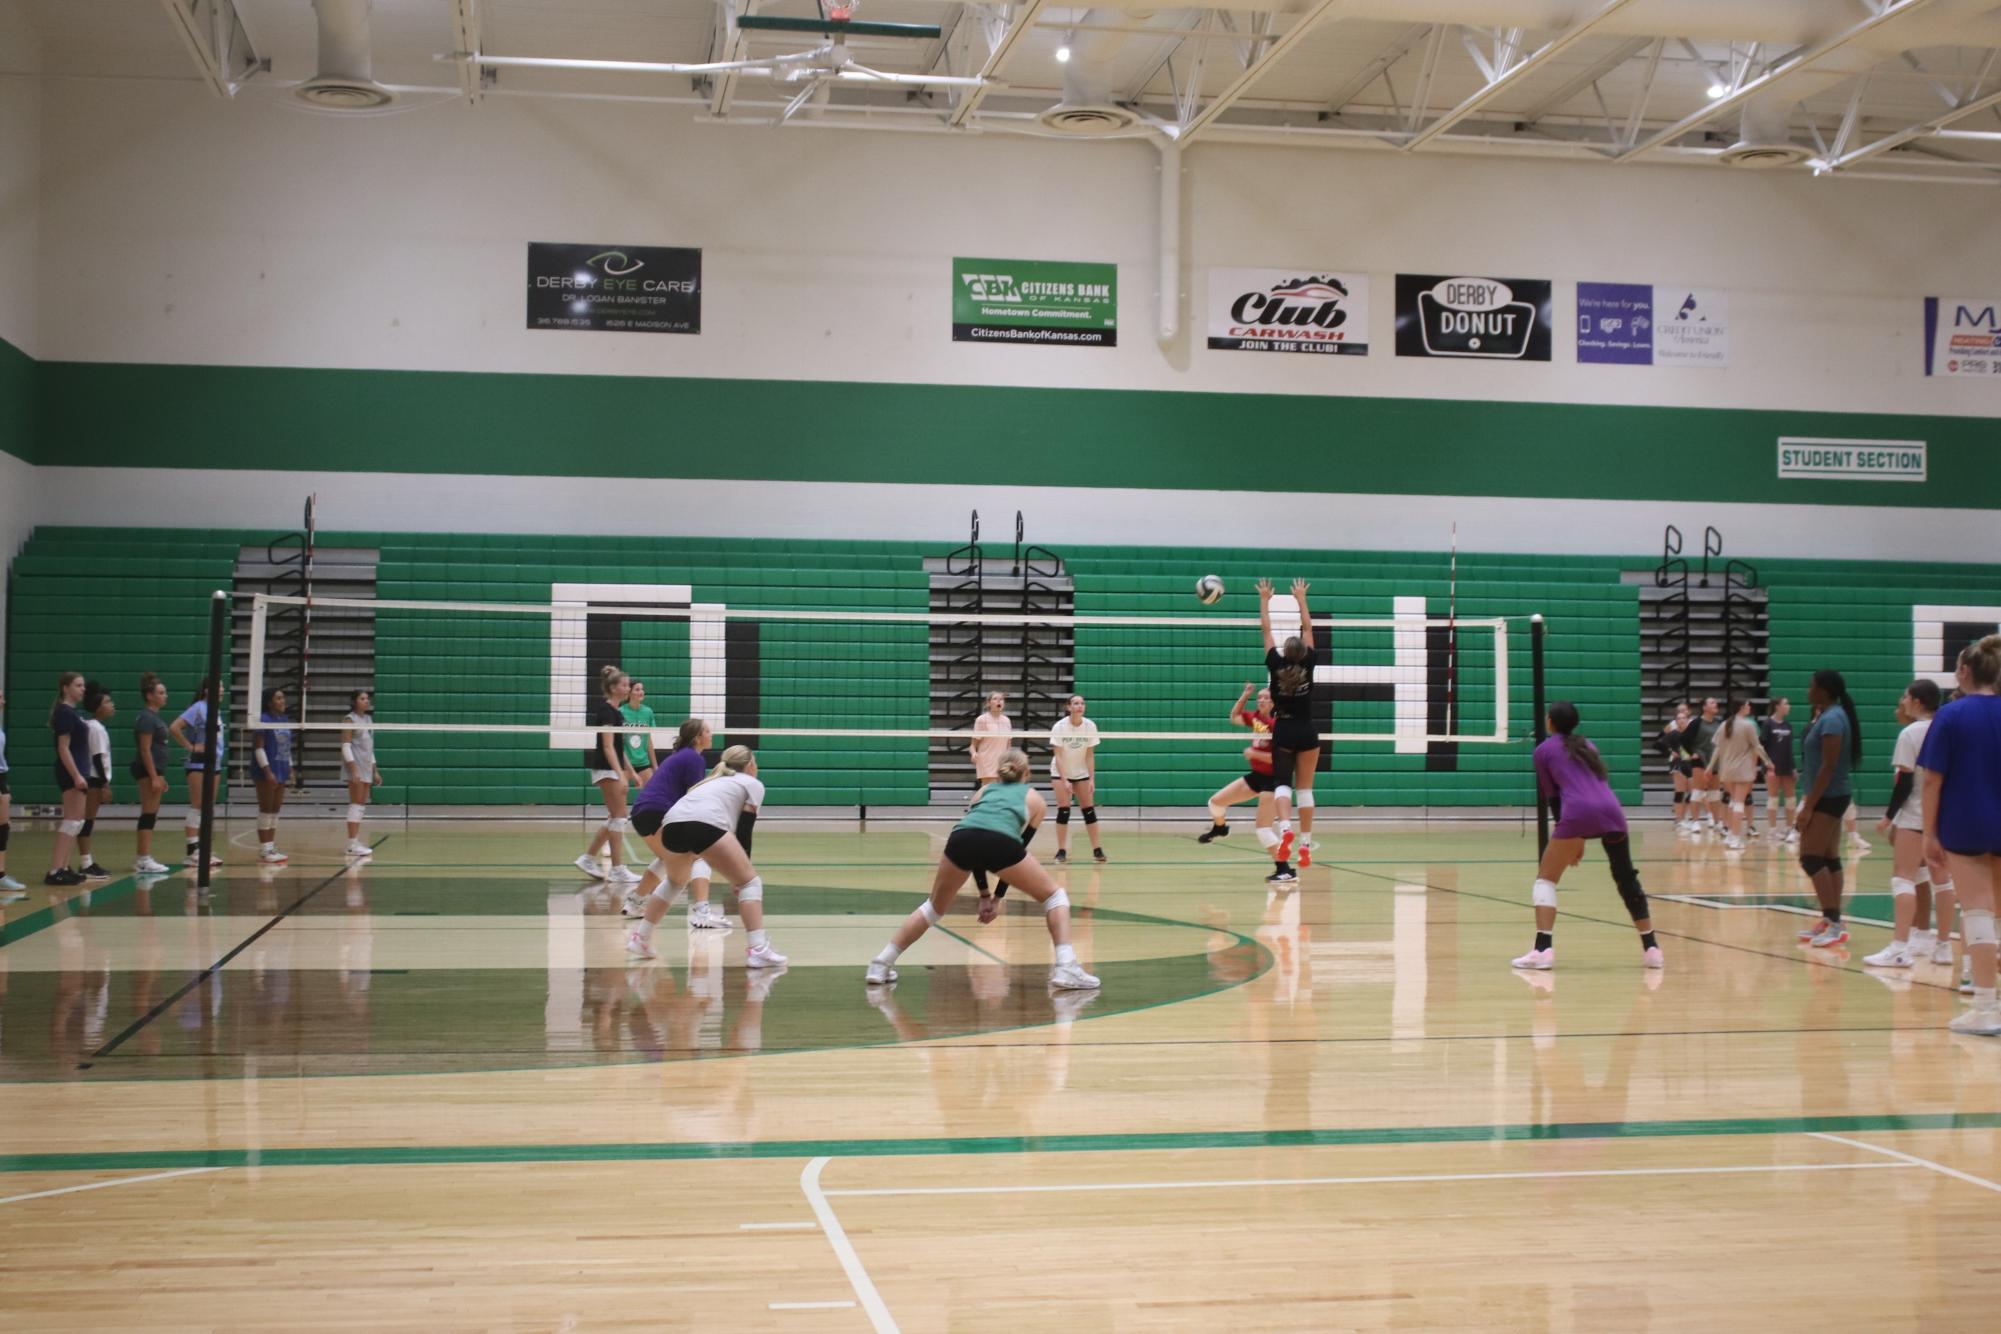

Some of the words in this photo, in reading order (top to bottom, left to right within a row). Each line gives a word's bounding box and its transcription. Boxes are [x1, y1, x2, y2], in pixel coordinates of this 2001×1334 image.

[536, 275, 598, 289] DERBY
[603, 278, 637, 290] EYE
[643, 279, 693, 293] CARE
[1020, 281, 1074, 296] CITIZENS
[1078, 284, 1110, 298] BANK
[617, 295, 667, 305] BANISTER
[1053, 296, 1110, 304] KANSAS
[1446, 283, 1498, 306] DERBY
[981, 306, 1030, 317] Hometown
[1031, 308, 1092, 319] Commitment.
[1230, 291, 1347, 329] Club
[1440, 311, 1517, 336] DONUT
[971, 327, 1102, 341] CitizensBankofKansas.com
[1228, 327, 1345, 341] CARWASH
[1238, 339, 1269, 351] JOIN
[1273, 340, 1297, 351] THE
[1301, 342, 1338, 353] CLUB!
[1782, 449, 1853, 467] STUDENT
[1857, 451, 1922, 469] SECTION
